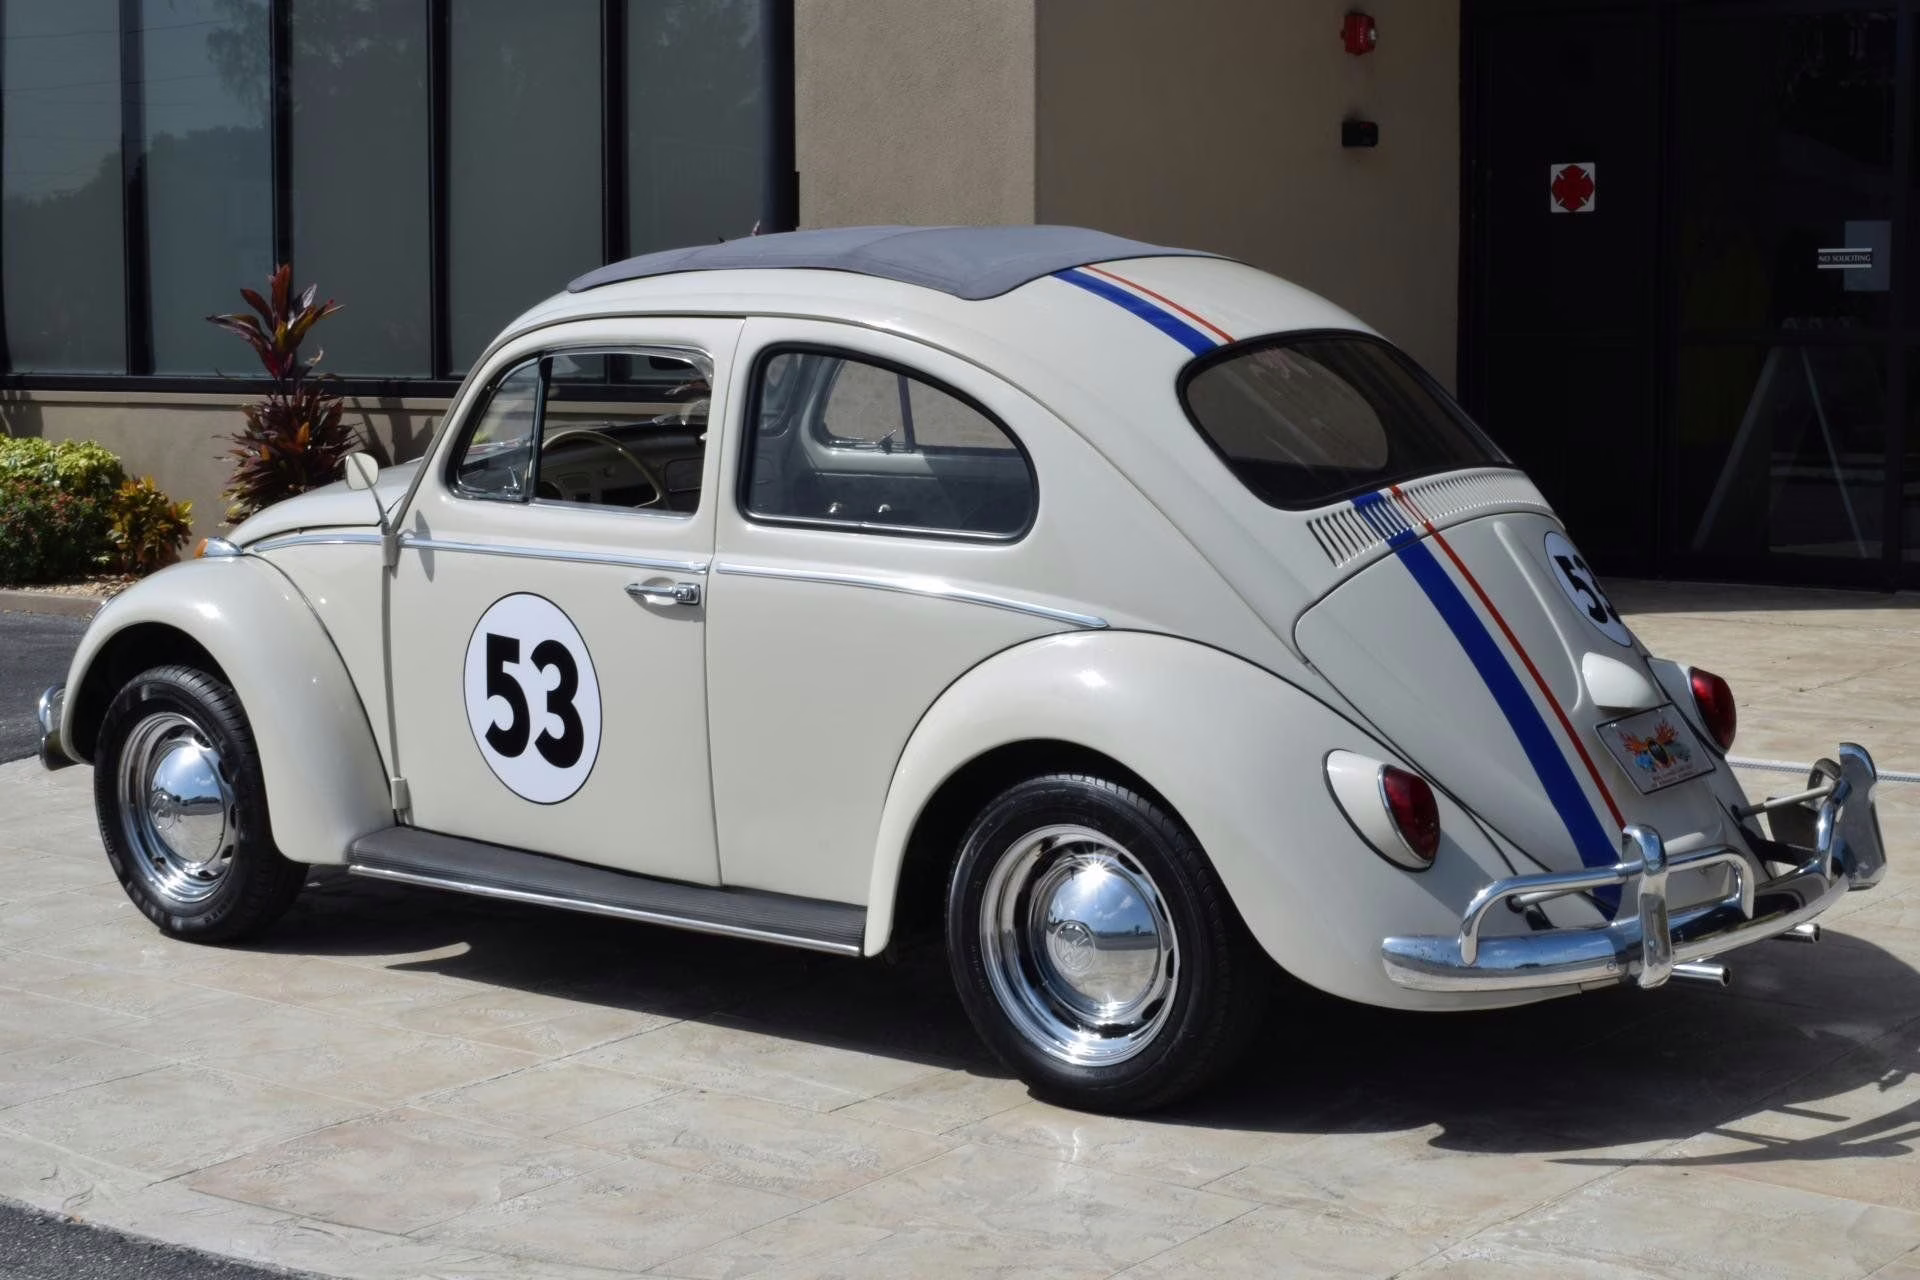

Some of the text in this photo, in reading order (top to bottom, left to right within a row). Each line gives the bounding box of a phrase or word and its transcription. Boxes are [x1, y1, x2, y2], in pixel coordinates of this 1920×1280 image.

[1818, 253, 1872, 262] NO SOLICITING
[1553, 554, 1622, 624] 53
[484, 632, 585, 768] 53
